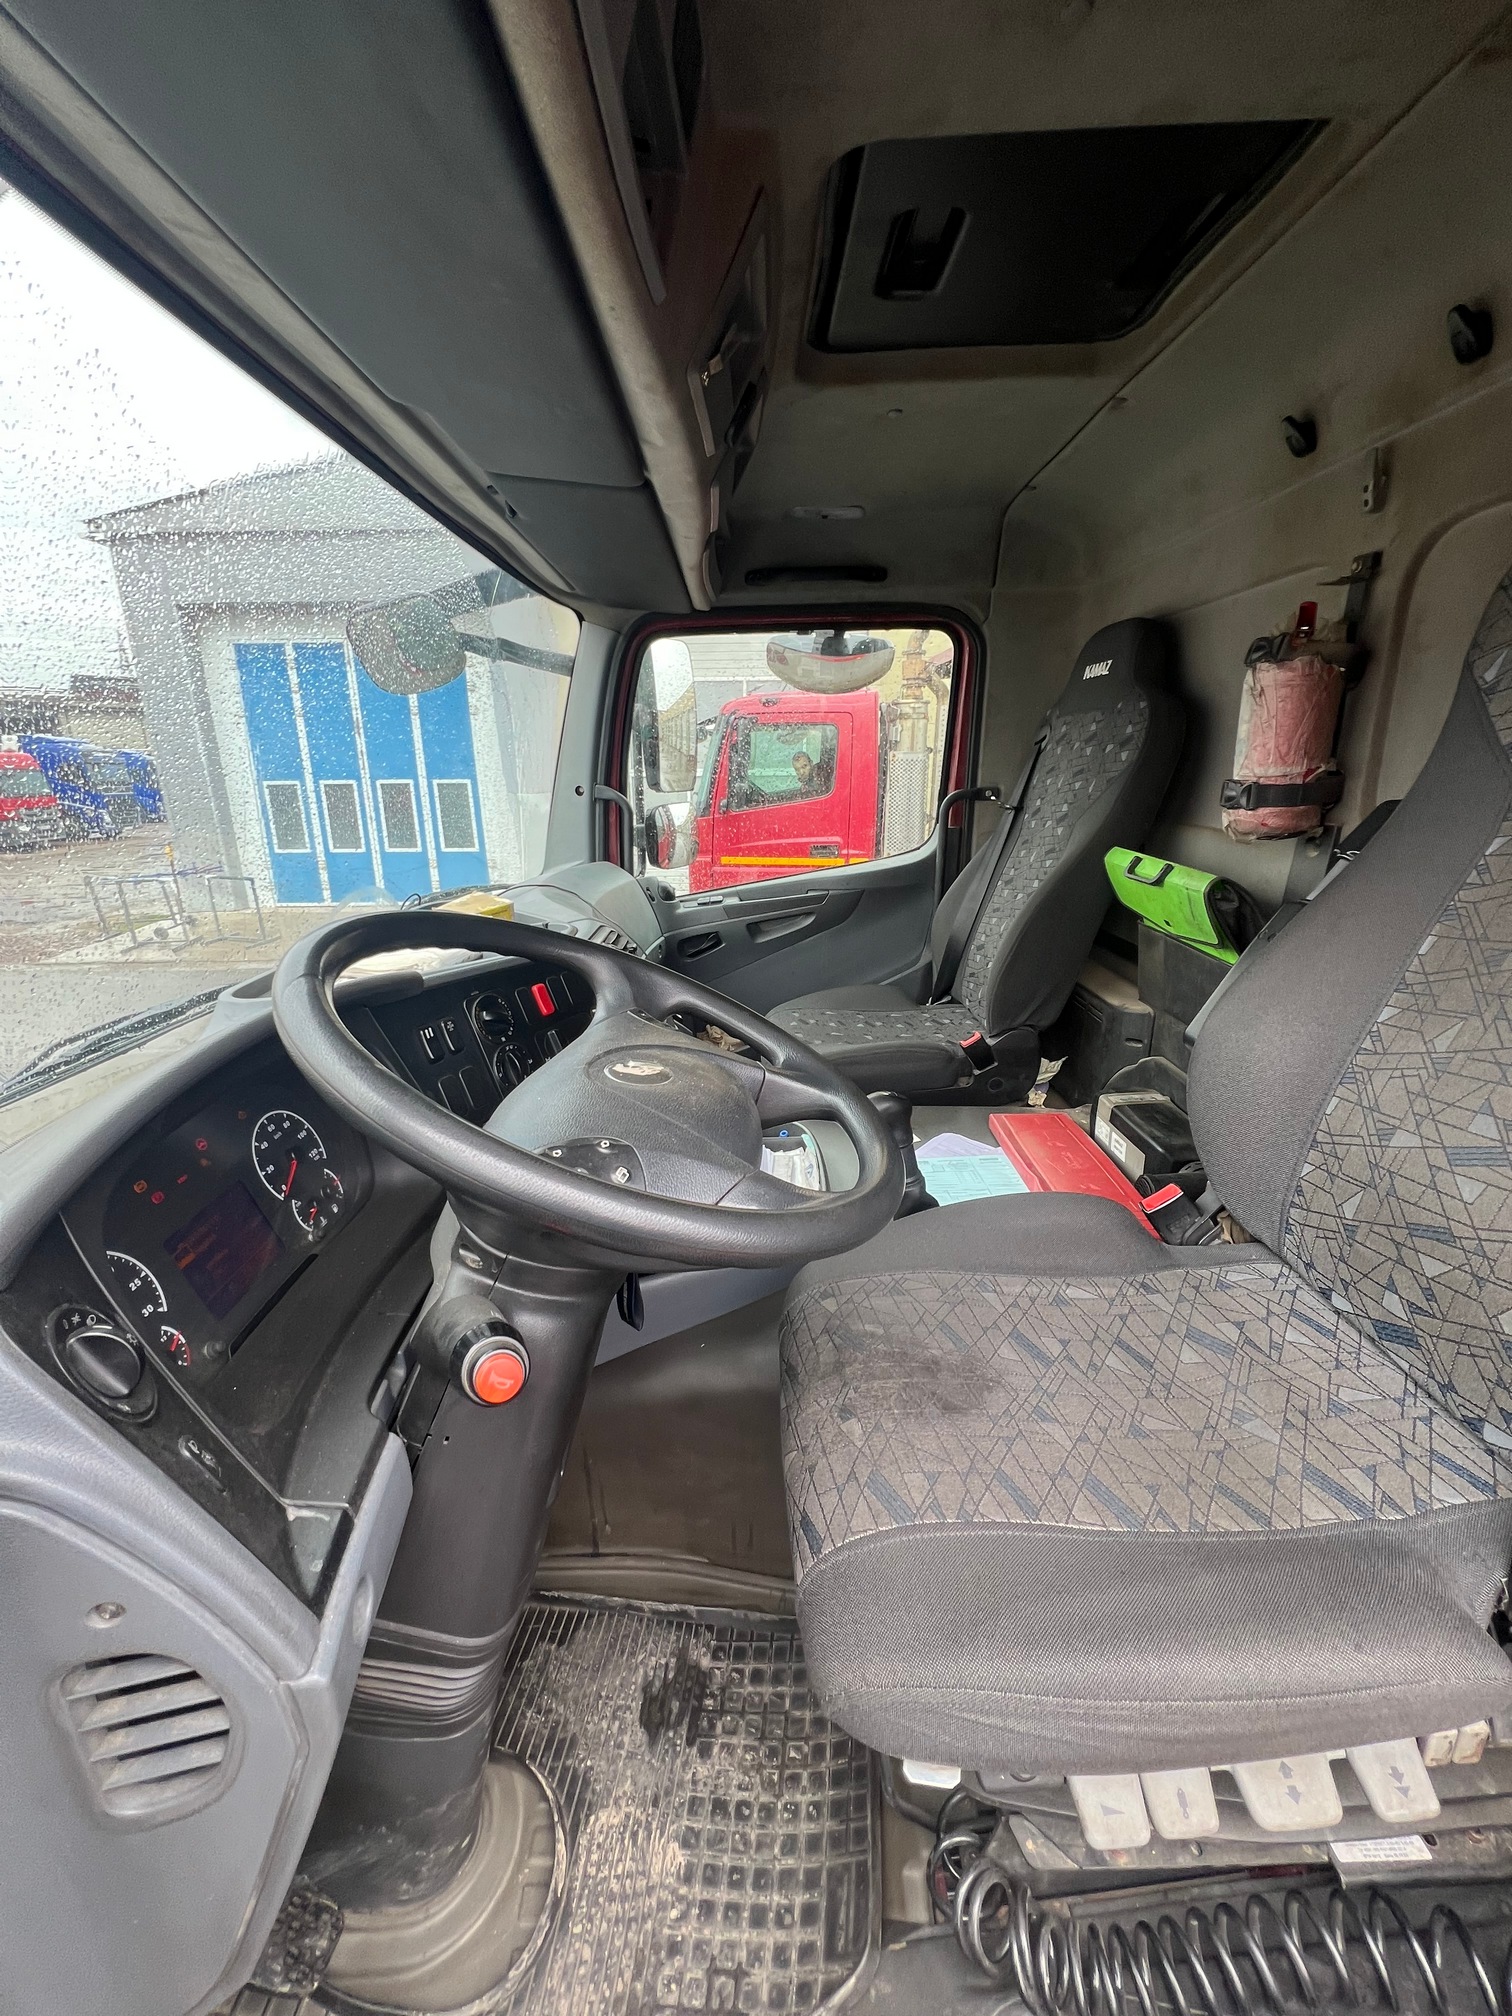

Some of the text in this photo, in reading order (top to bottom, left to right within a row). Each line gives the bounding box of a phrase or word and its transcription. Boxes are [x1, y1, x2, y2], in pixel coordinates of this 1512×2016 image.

[267, 1123, 276, 1133] 60
[297, 1129, 308, 1140] 100
[260, 1141, 269, 1150] 40
[308, 1148, 318, 1158] 120
[266, 1164, 275, 1174] 20
[129, 1278, 142, 1291] 25
[141, 1304, 154, 1317] 30
